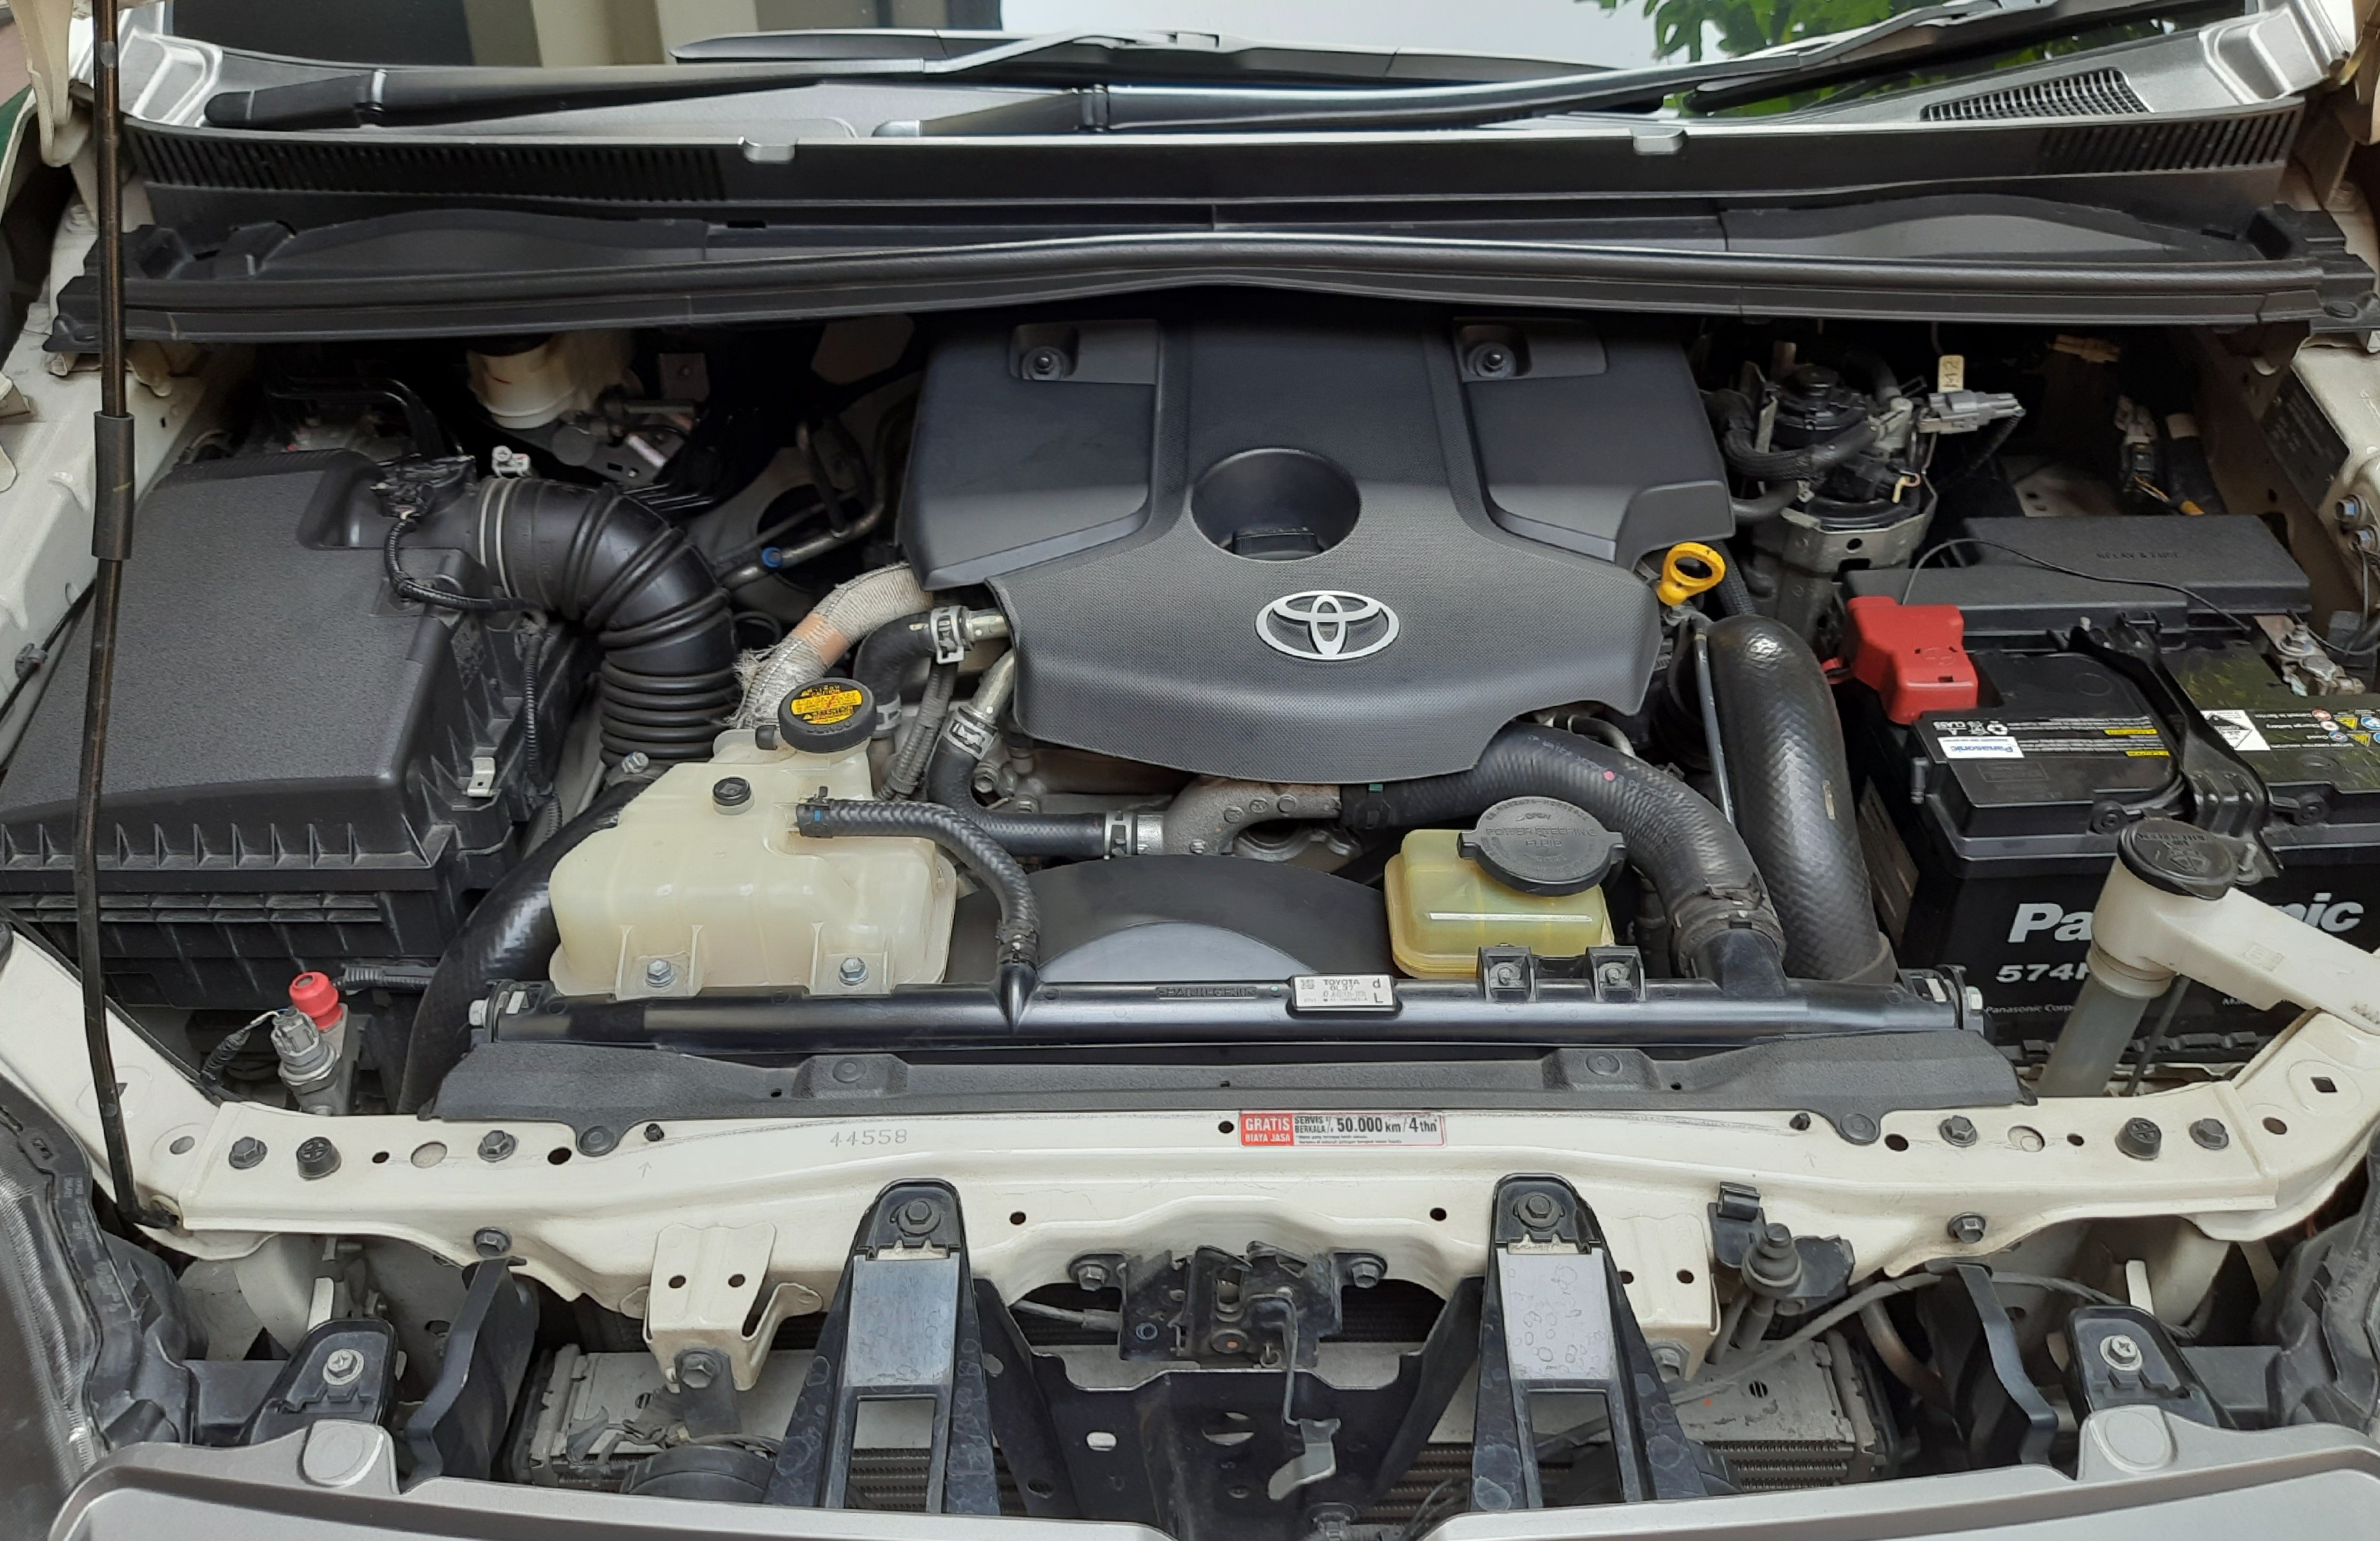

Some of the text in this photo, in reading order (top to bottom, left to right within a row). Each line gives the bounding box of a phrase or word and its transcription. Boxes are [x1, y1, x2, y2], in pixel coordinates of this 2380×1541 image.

[1486, 826, 1597, 836] POWER STEERING
[1374, 992, 1384, 1004] L
[1986, 1005, 2042, 1014] Panasonic
[1245, 1116, 1291, 1131] GRATIS
[1295, 1115, 1323, 1125] SERVIS
[1337, 1117, 1383, 1132] 50.000
[1295, 1125, 1326, 1134] BERKALA
[830, 1129, 908, 1147] 44558
[1245, 1133, 1268, 1142] BIAYA
[1270, 1133, 1291, 1142] JASA
